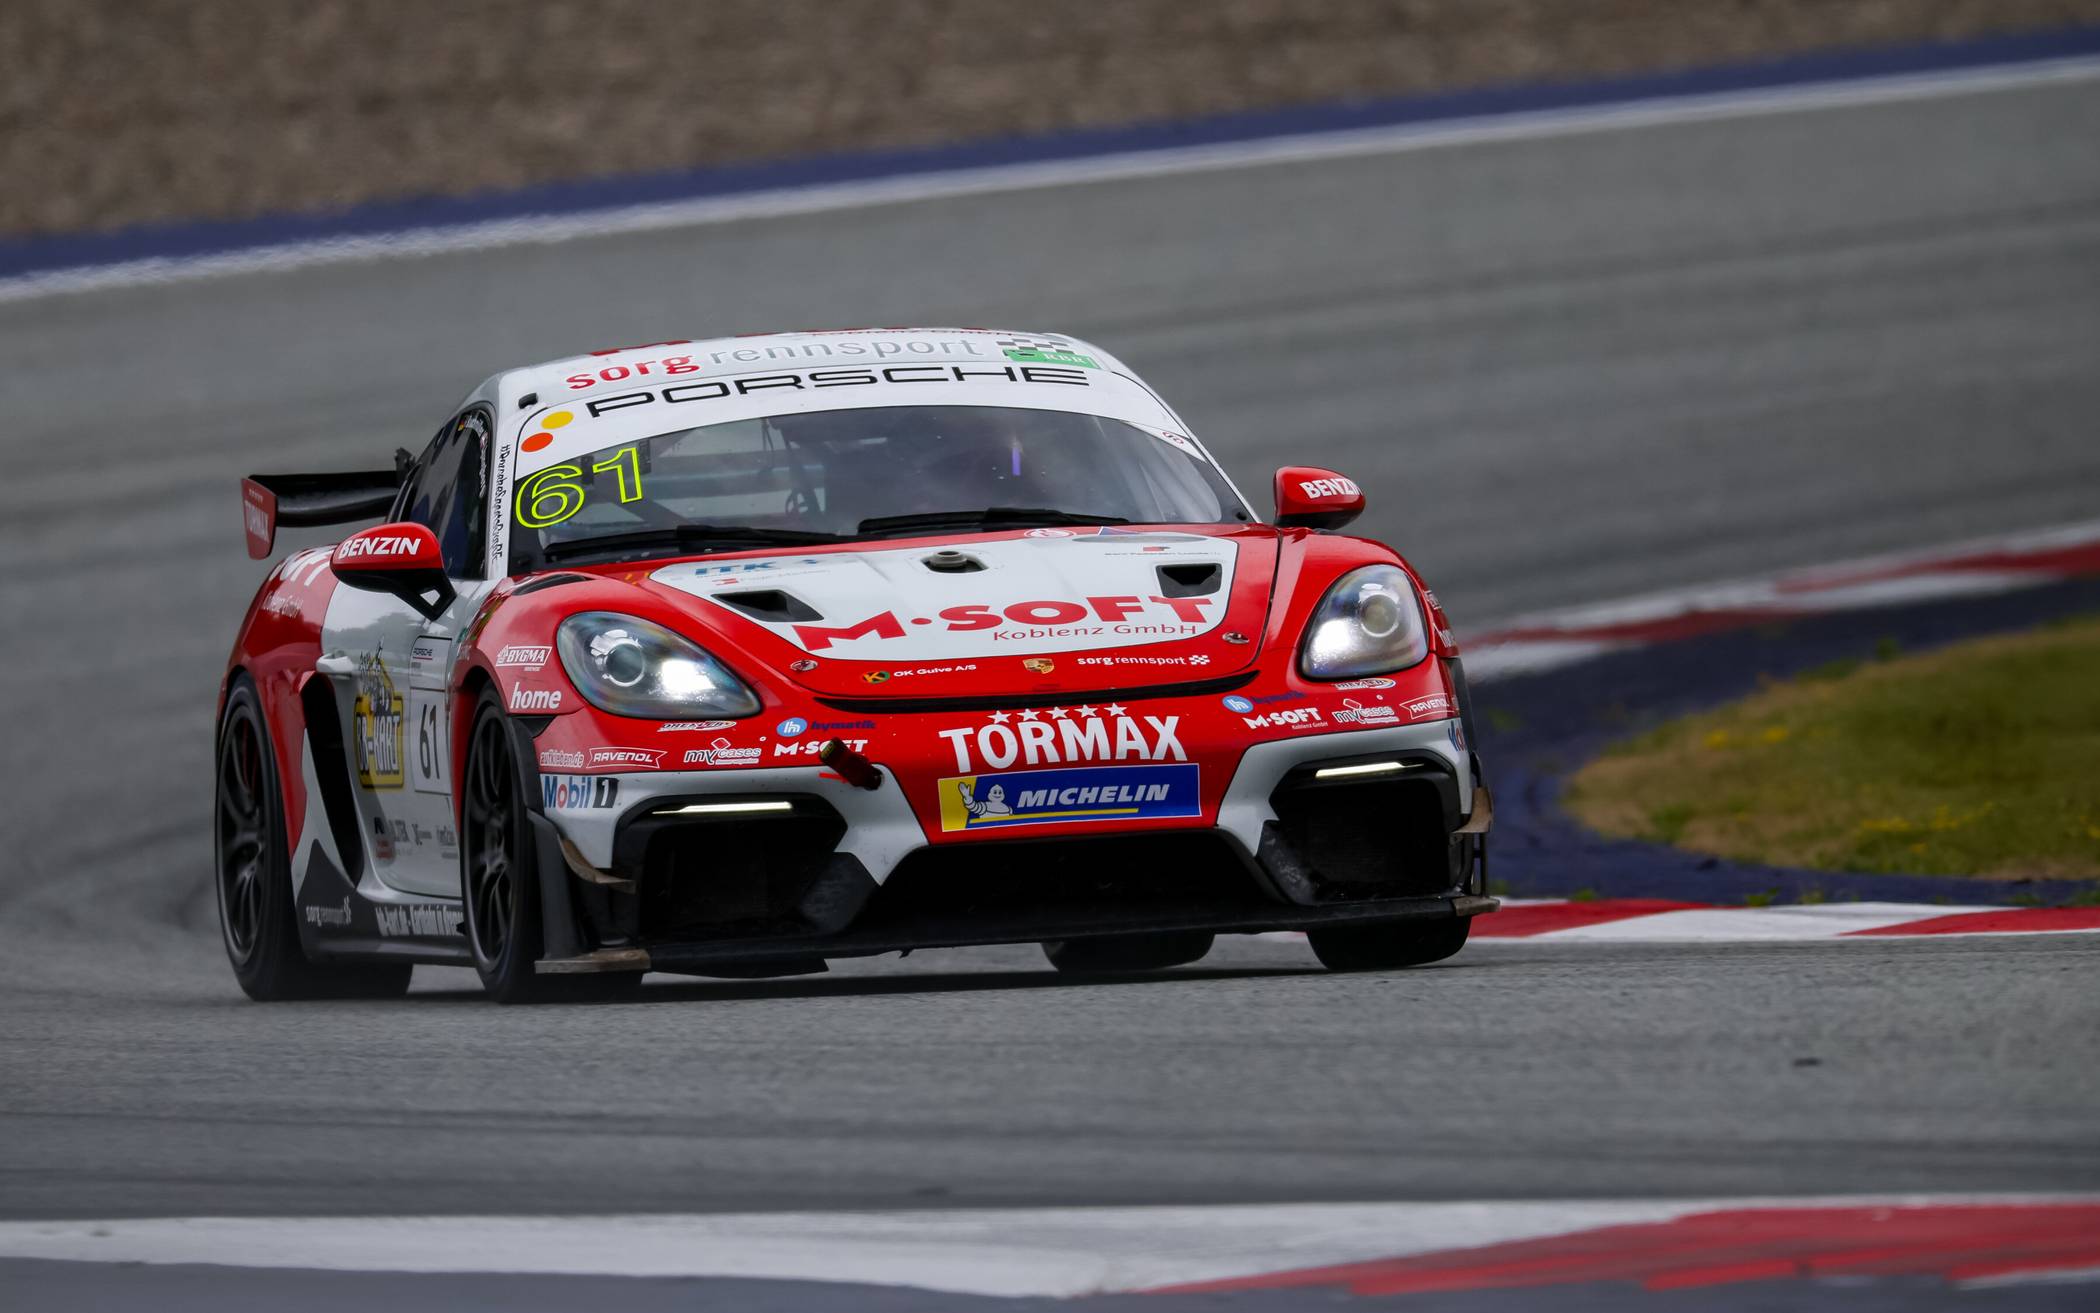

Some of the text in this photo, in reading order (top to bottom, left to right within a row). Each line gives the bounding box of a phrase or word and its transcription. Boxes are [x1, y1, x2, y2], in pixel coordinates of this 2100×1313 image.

[565, 339, 984, 390] sorg rennsport
[585, 365, 1090, 418] PORSCHE
[515, 447, 644, 528] 61
[337, 536, 422, 560] BENZIN
[695, 560, 779, 576] ITK
[993, 623, 1198, 641] Koblenz GmbH
[506, 649, 546, 663] BYGMA
[1077, 655, 1187, 667] sorg rennsport
[510, 681, 562, 709] home
[419, 703, 441, 780] 61
[938, 715, 1189, 774] TORMAX
[592, 750, 655, 763] RAVENOL
[543, 775, 592, 810] Mobil
[1016, 783, 1170, 809] MICHELIN
